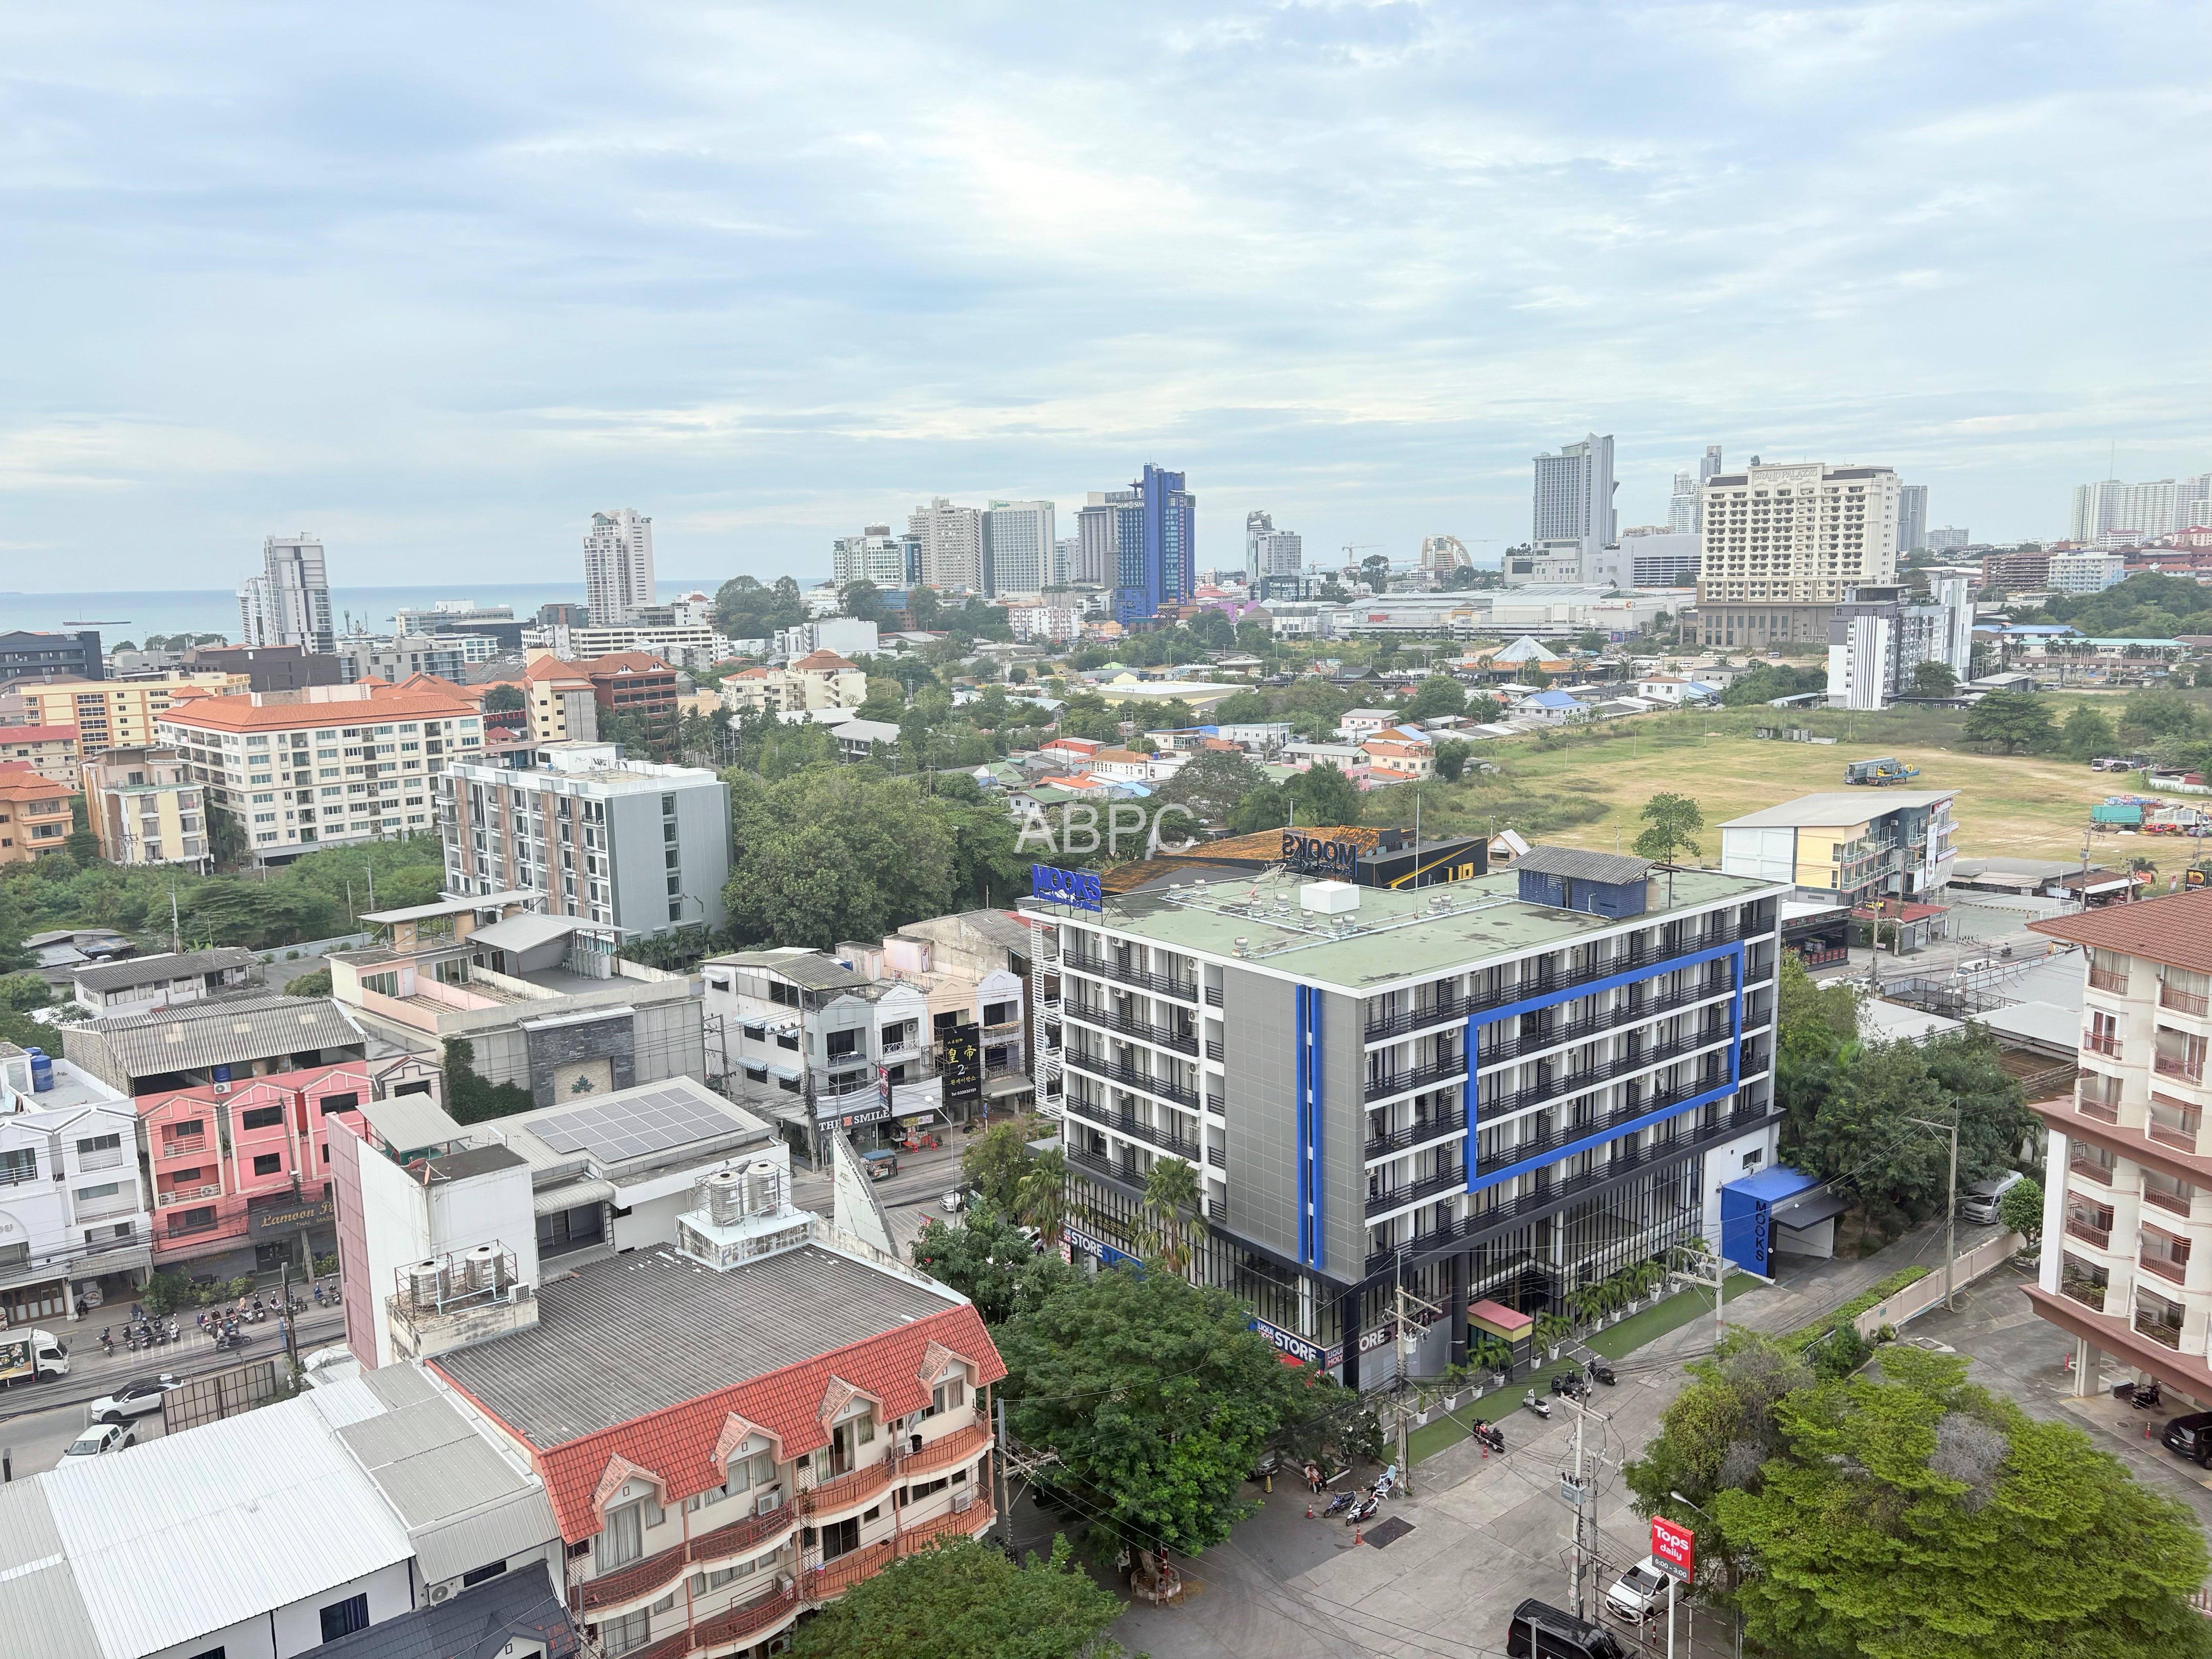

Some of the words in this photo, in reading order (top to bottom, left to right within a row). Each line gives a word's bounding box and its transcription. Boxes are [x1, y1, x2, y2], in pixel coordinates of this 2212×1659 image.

[1753, 471, 1781, 479] GRAND
[1782, 469, 1817, 478] PALAZZO
[506, 711, 526, 719] CLU
[1032, 864, 1101, 901] MOOKS
[957, 1064, 965, 1075] 2
[854, 1109, 890, 1124] SMILE
[261, 1209, 315, 1227] Lamoon
[1755, 1200, 1766, 1261] MOOKS
[1072, 1231, 1103, 1258] STORE
[1258, 1322, 1274, 1336] LIQUI
[1274, 1331, 1317, 1362] STORE
[1360, 1328, 1385, 1351] ORE
[1328, 1354, 1343, 1366] MOLY
[1654, 1525, 1689, 1551] Tops
[1660, 1544, 1682, 1561] daily
